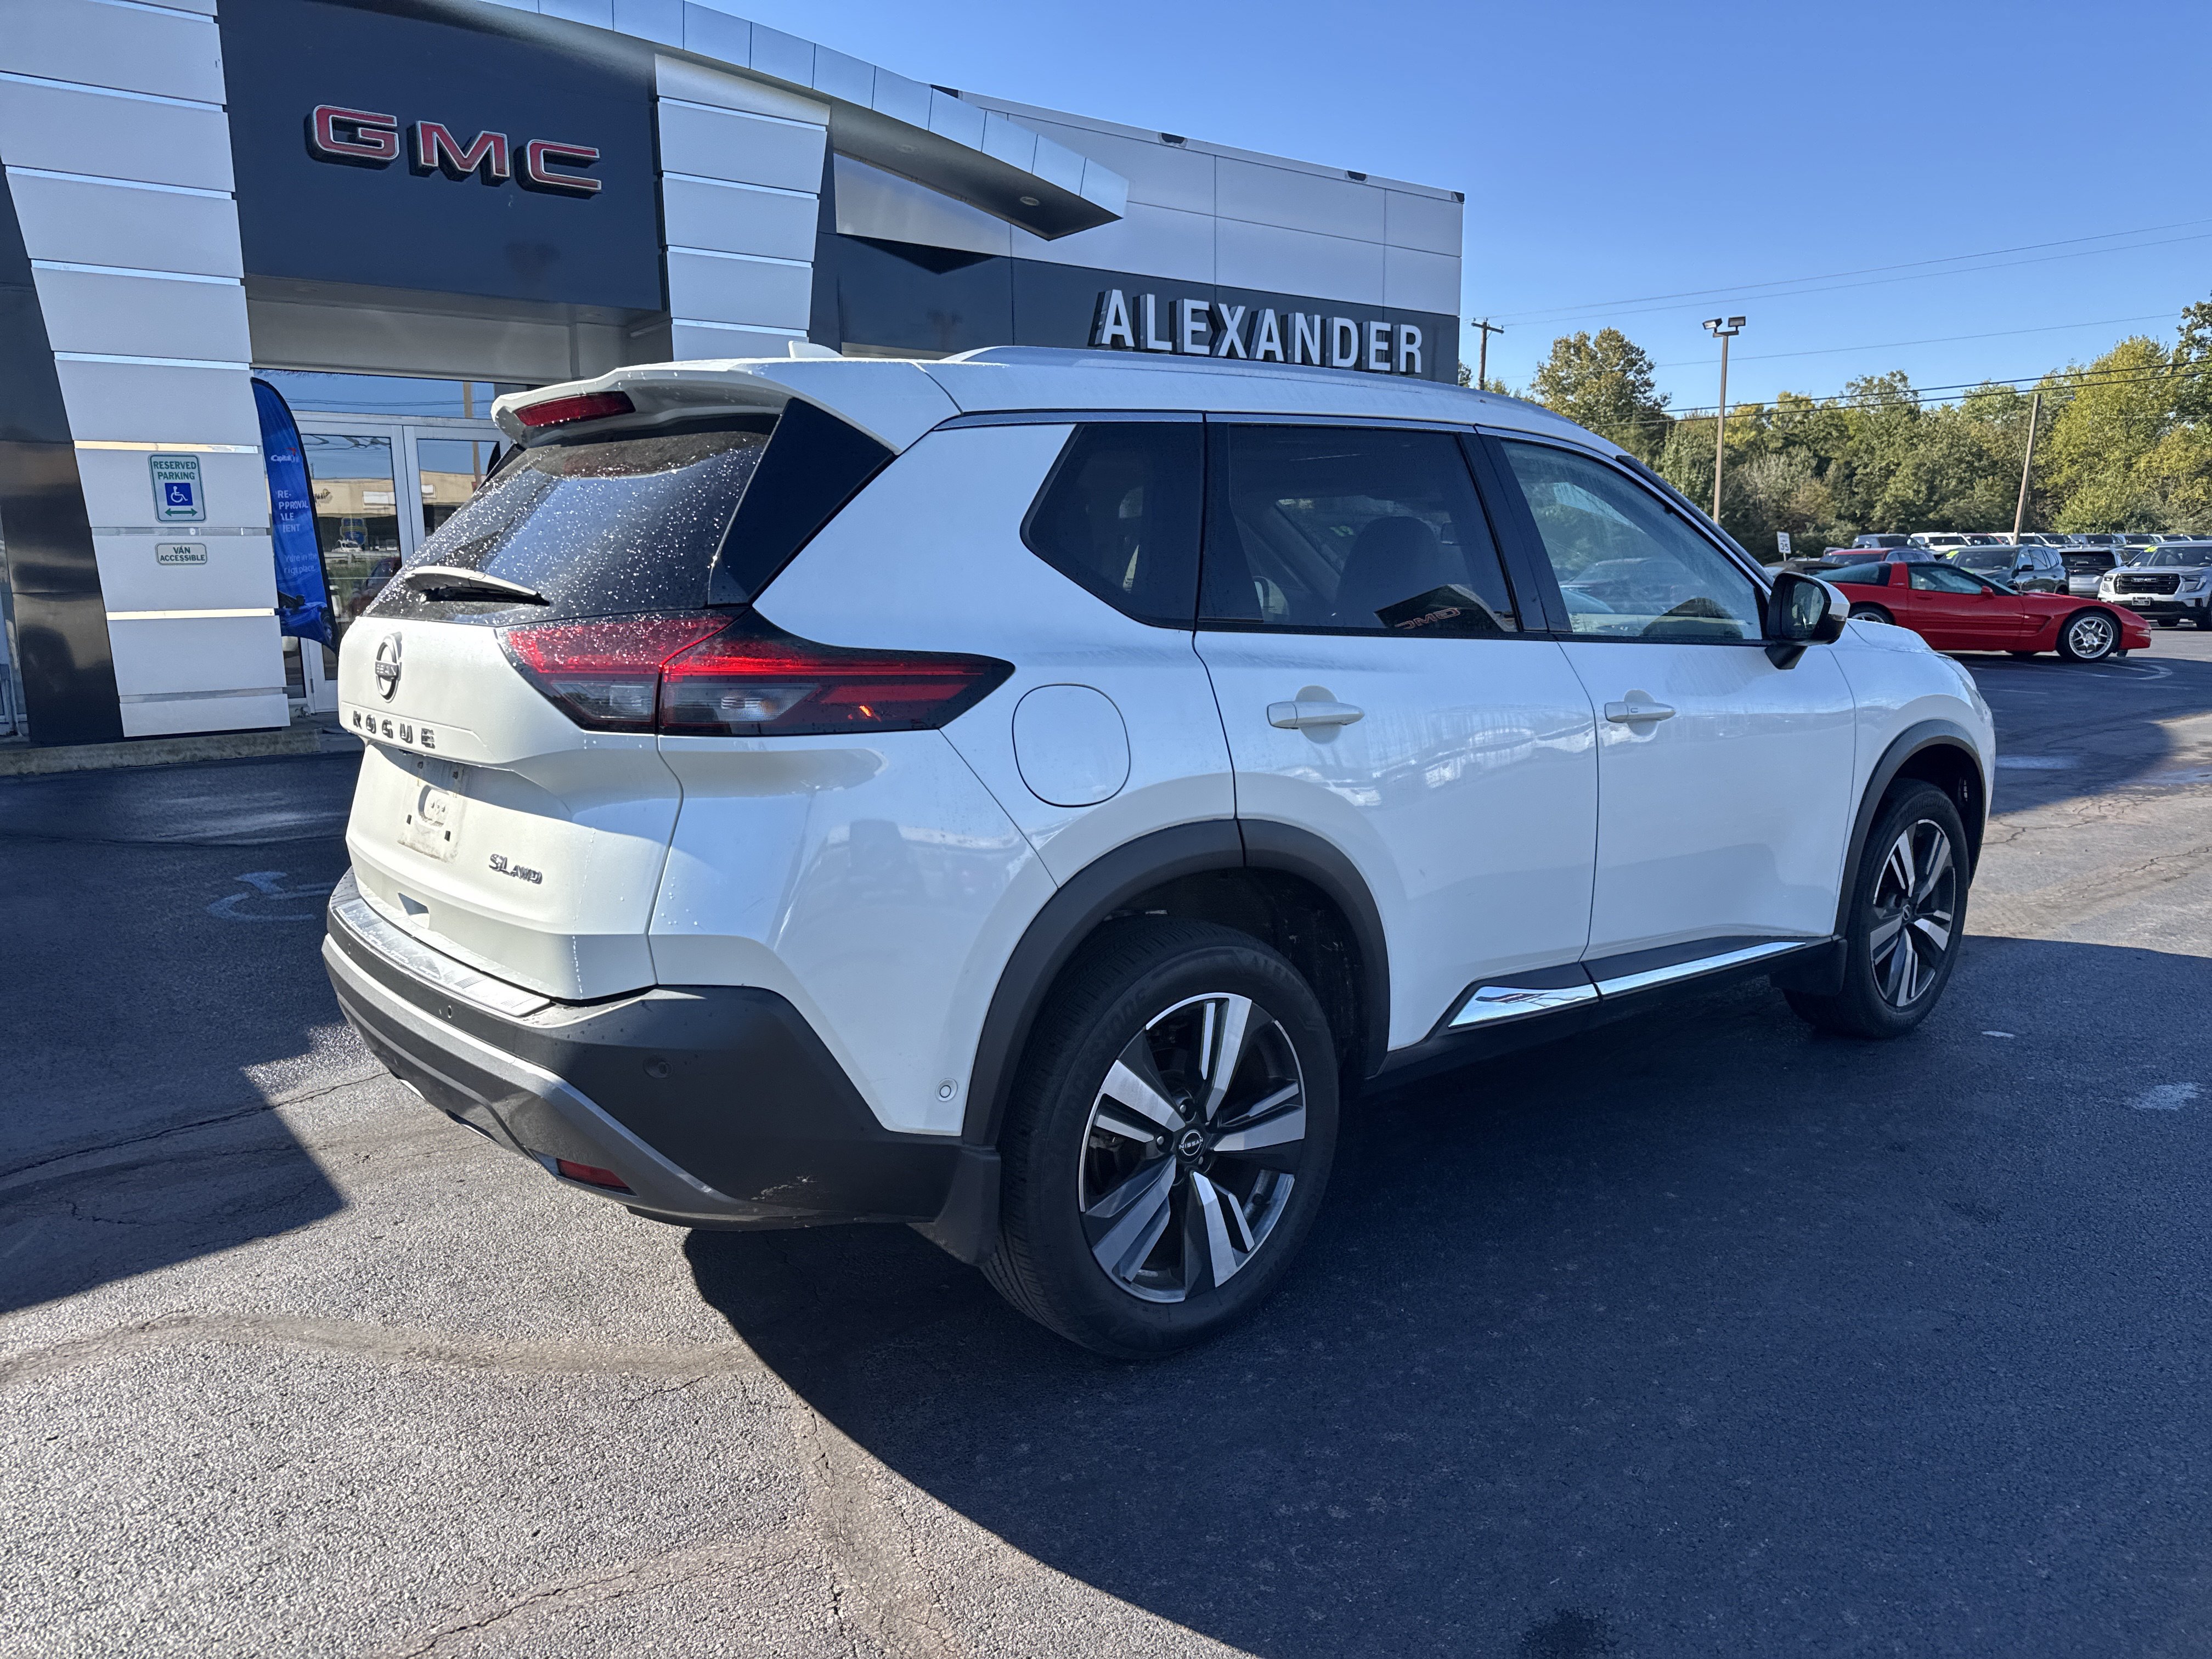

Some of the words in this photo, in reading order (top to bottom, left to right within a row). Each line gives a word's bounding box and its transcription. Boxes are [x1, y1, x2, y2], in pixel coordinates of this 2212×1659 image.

[313, 104, 602, 190] GMC
[1101, 289, 1423, 373] ALEXANDER
[153, 461, 196, 470] RESERVED
[157, 472, 195, 480] PARKING
[275, 490, 291, 499] RE-
[279, 500, 309, 510] PPROVAL
[173, 545, 191, 554] VAN
[1780, 543, 1790, 551] 35
[353, 710, 436, 749] ROGUE
[1178, 1137, 1204, 1150] NISSAN
